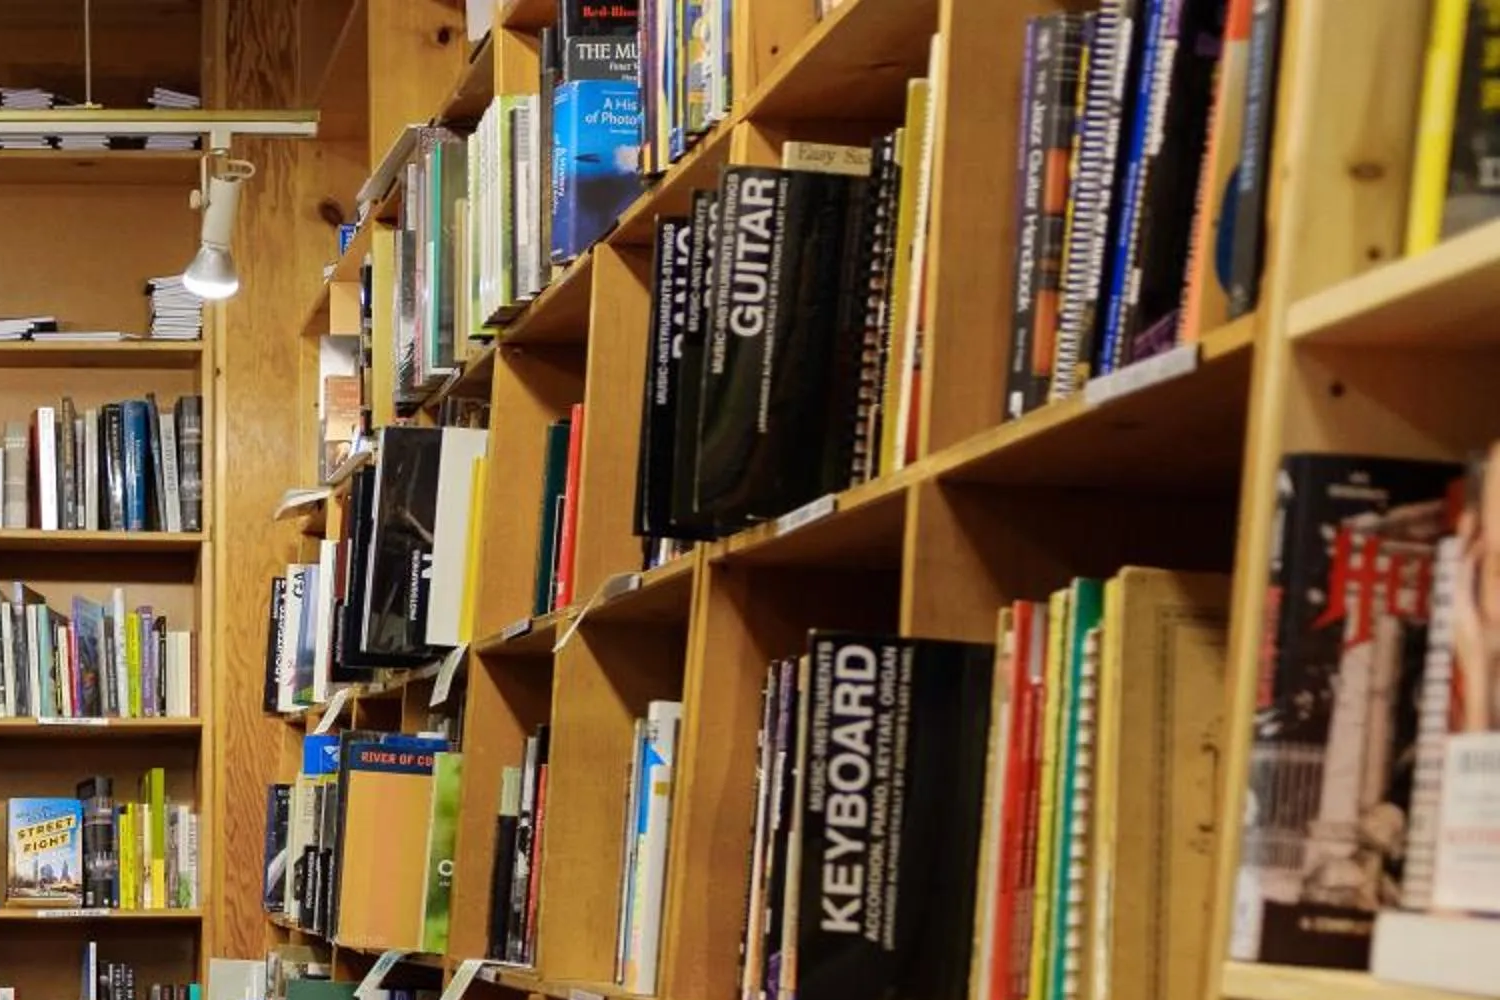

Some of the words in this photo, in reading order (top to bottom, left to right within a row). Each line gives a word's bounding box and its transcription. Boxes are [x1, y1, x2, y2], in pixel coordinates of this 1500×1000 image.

[576, 43, 610, 60] THE
[615, 43, 639, 60] MU
[585, 112, 600, 125] of
[1030, 100, 1047, 146] Jazz
[1025, 149, 1045, 210] Guitar
[729, 176, 776, 337] GUITAR
[1016, 213, 1040, 313] Handbook
[361, 750, 396, 765] RIVER
[398, 753, 415, 766] OF
[820, 643, 878, 932] KEYBOARD
[17, 816, 74, 840] STREET
[23, 833, 68, 853] FIGHT
